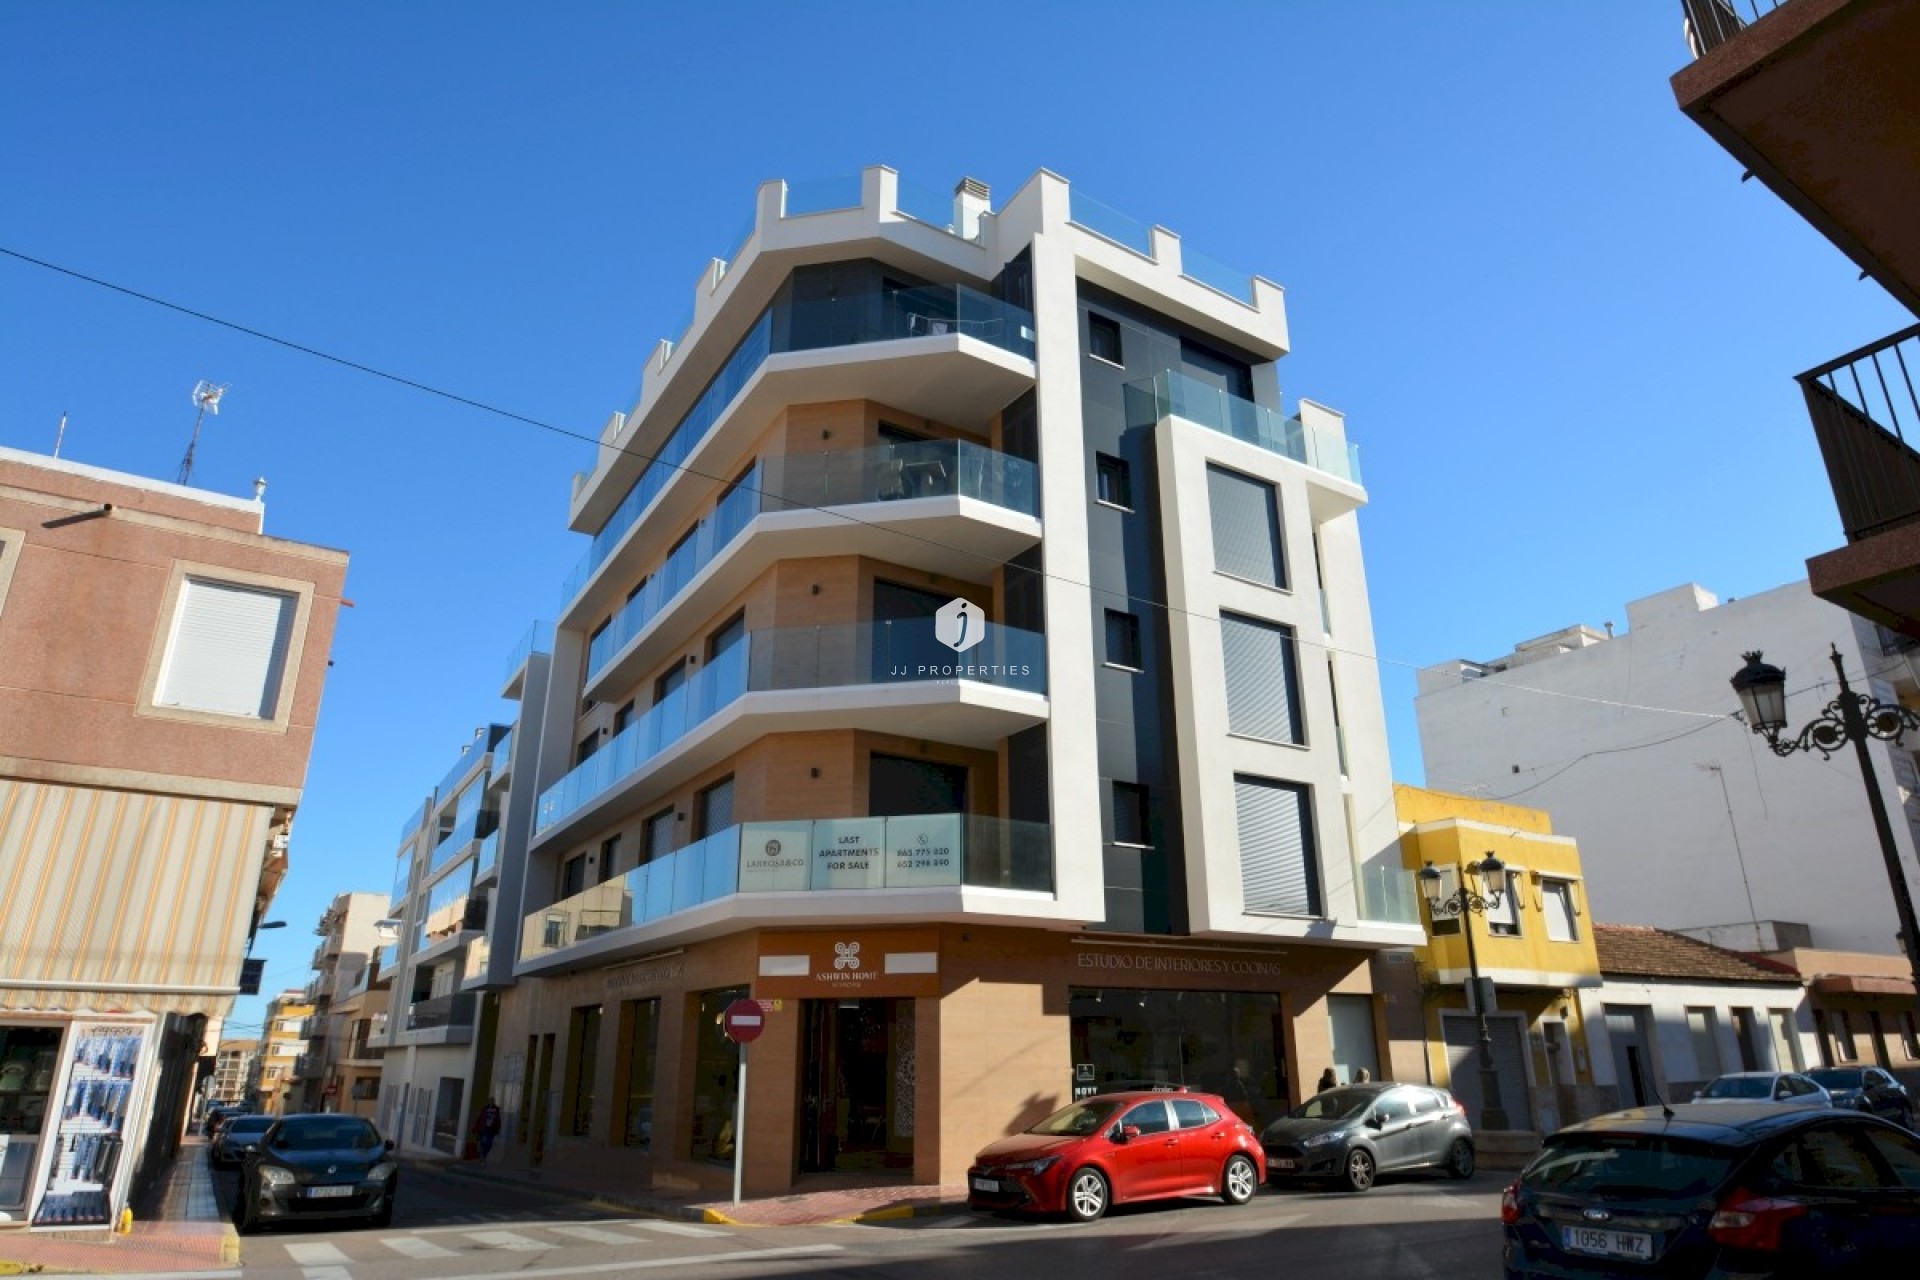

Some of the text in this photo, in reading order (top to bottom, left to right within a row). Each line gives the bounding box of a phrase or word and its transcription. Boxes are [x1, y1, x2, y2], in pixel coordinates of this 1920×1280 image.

[838, 836, 861, 844] LAST
[818, 848, 880, 857] APARTMENTS
[827, 861, 870, 870] FOR SALE
[1077, 953, 1281, 975] ESTUDIO DE INTERIORES Y COCINAS
[1574, 1230, 1608, 1249] 1056
